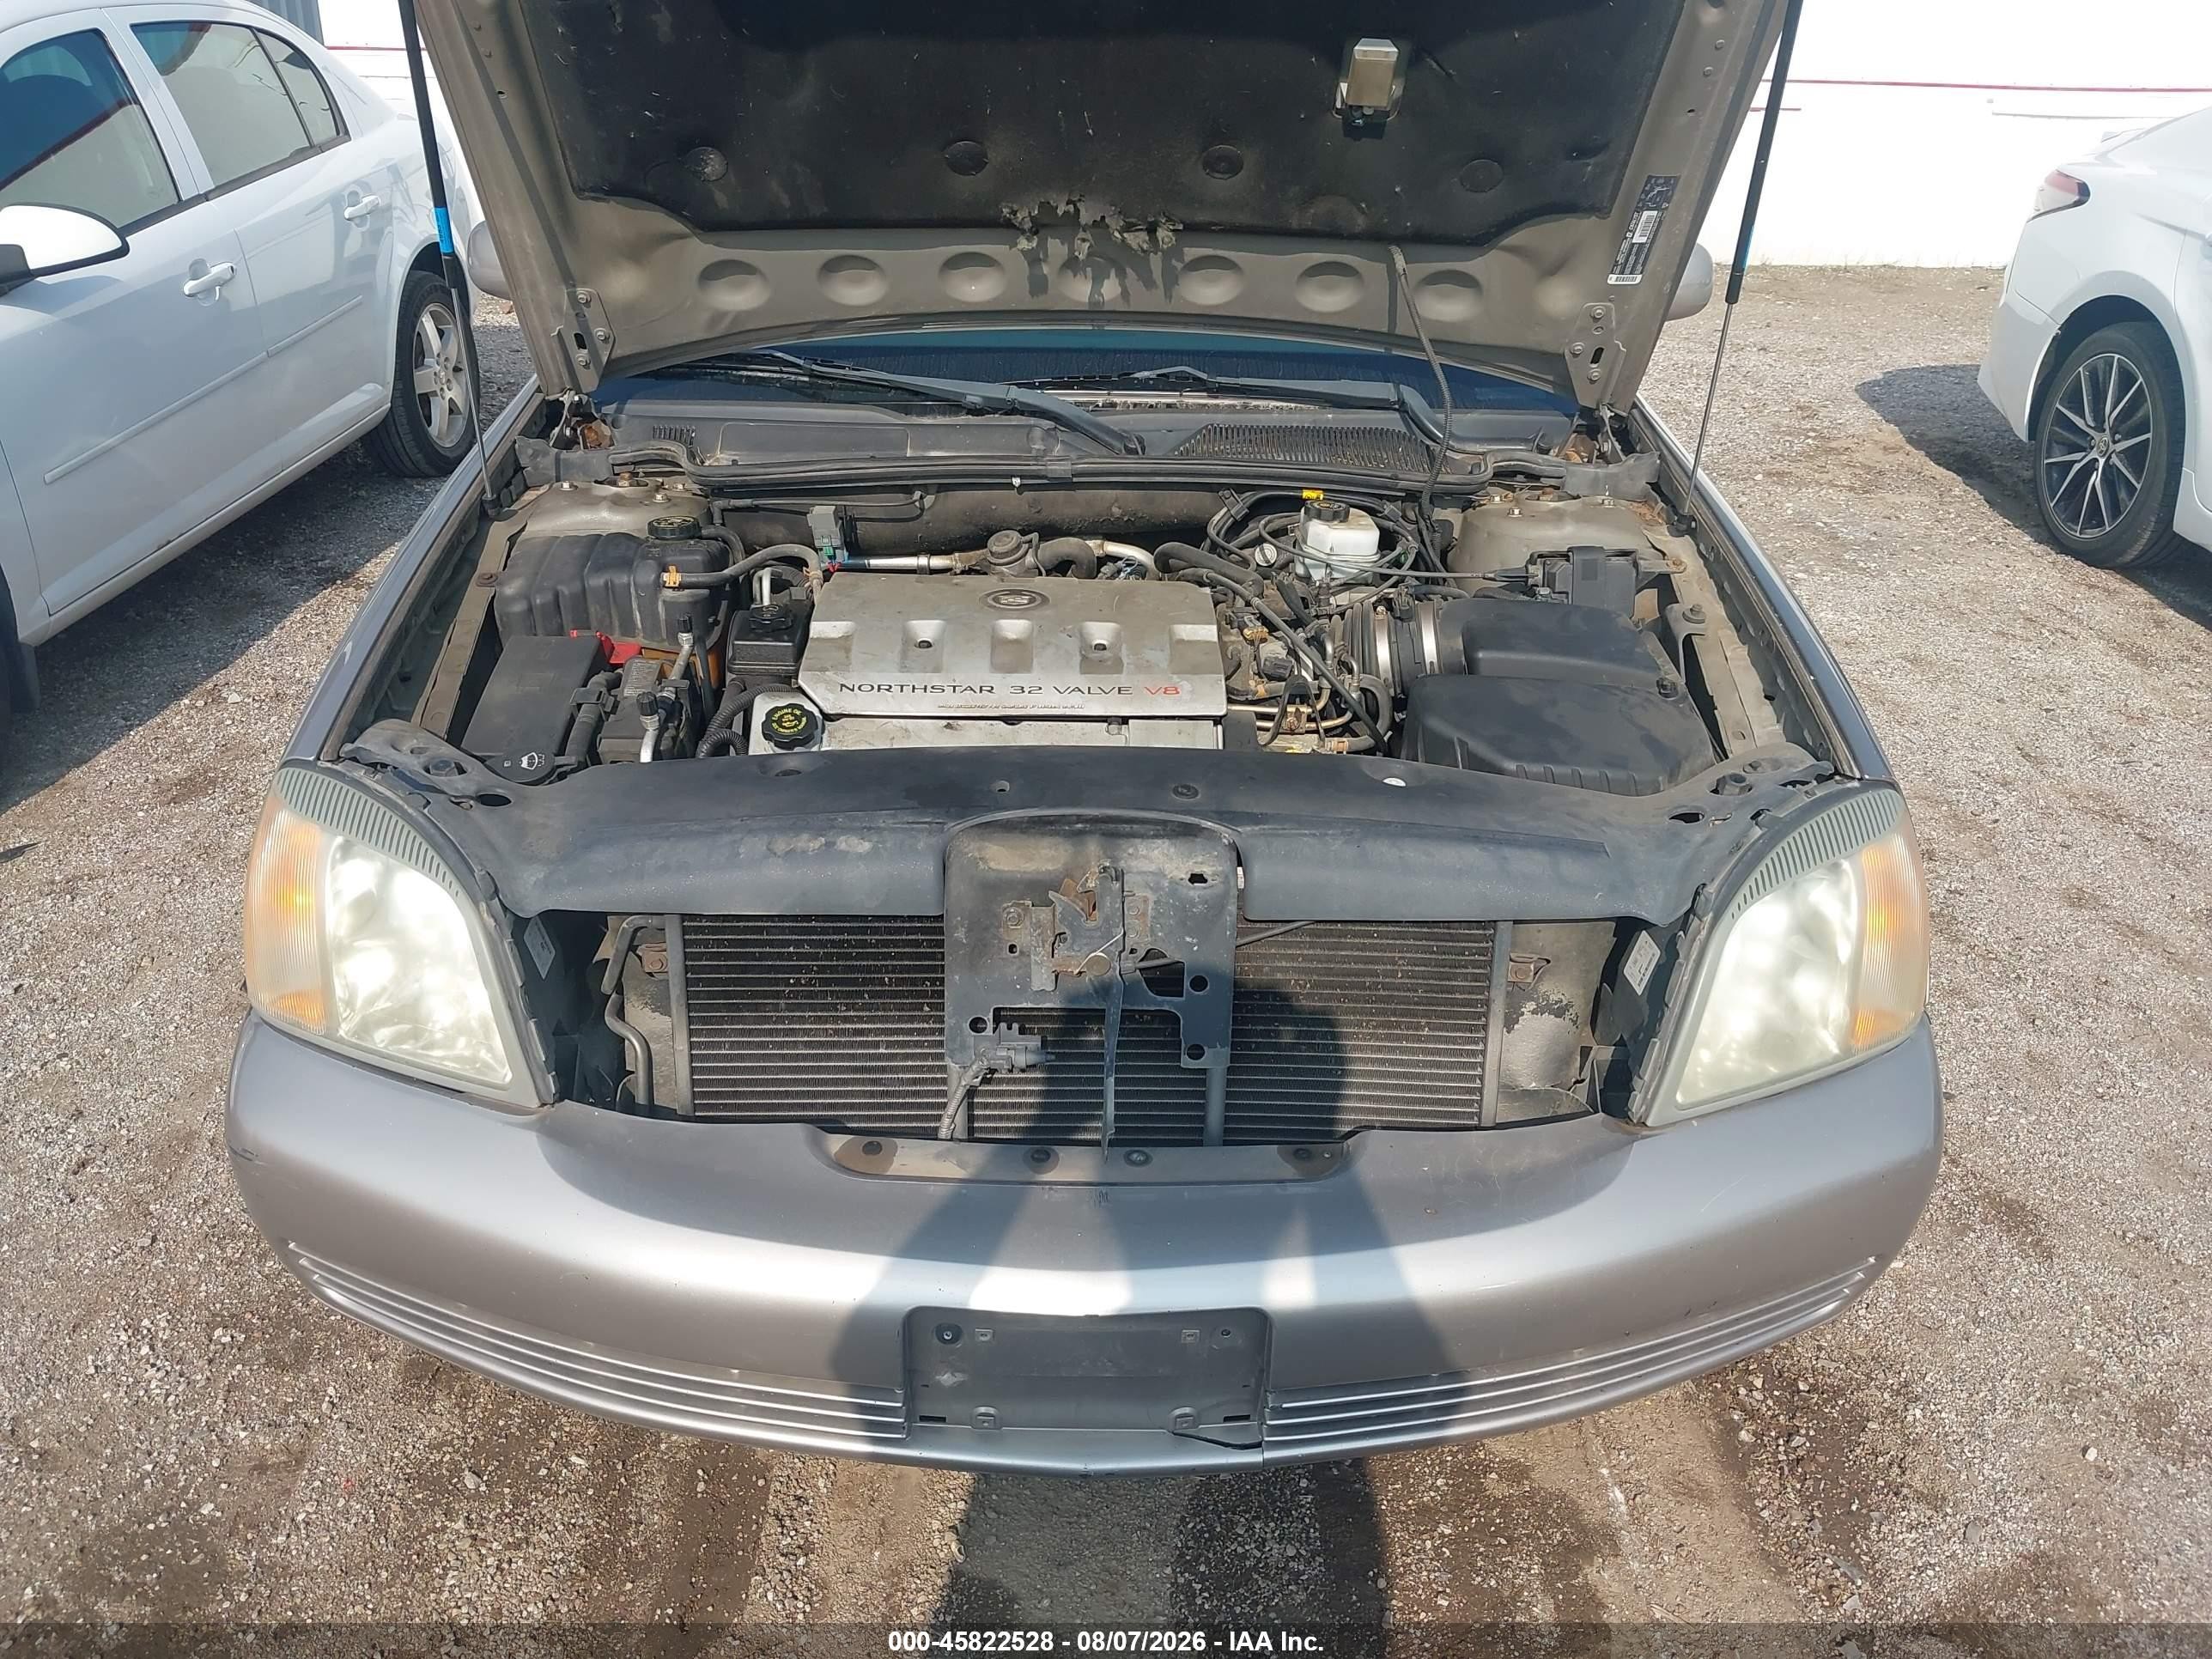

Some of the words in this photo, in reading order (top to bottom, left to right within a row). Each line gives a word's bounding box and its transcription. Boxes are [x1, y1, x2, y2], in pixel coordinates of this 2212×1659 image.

[839, 683, 996, 694] NORTHSTAR
[1009, 685, 1043, 695] 32
[1053, 685, 1133, 695] VALVE
[1145, 686, 1180, 695] V8
